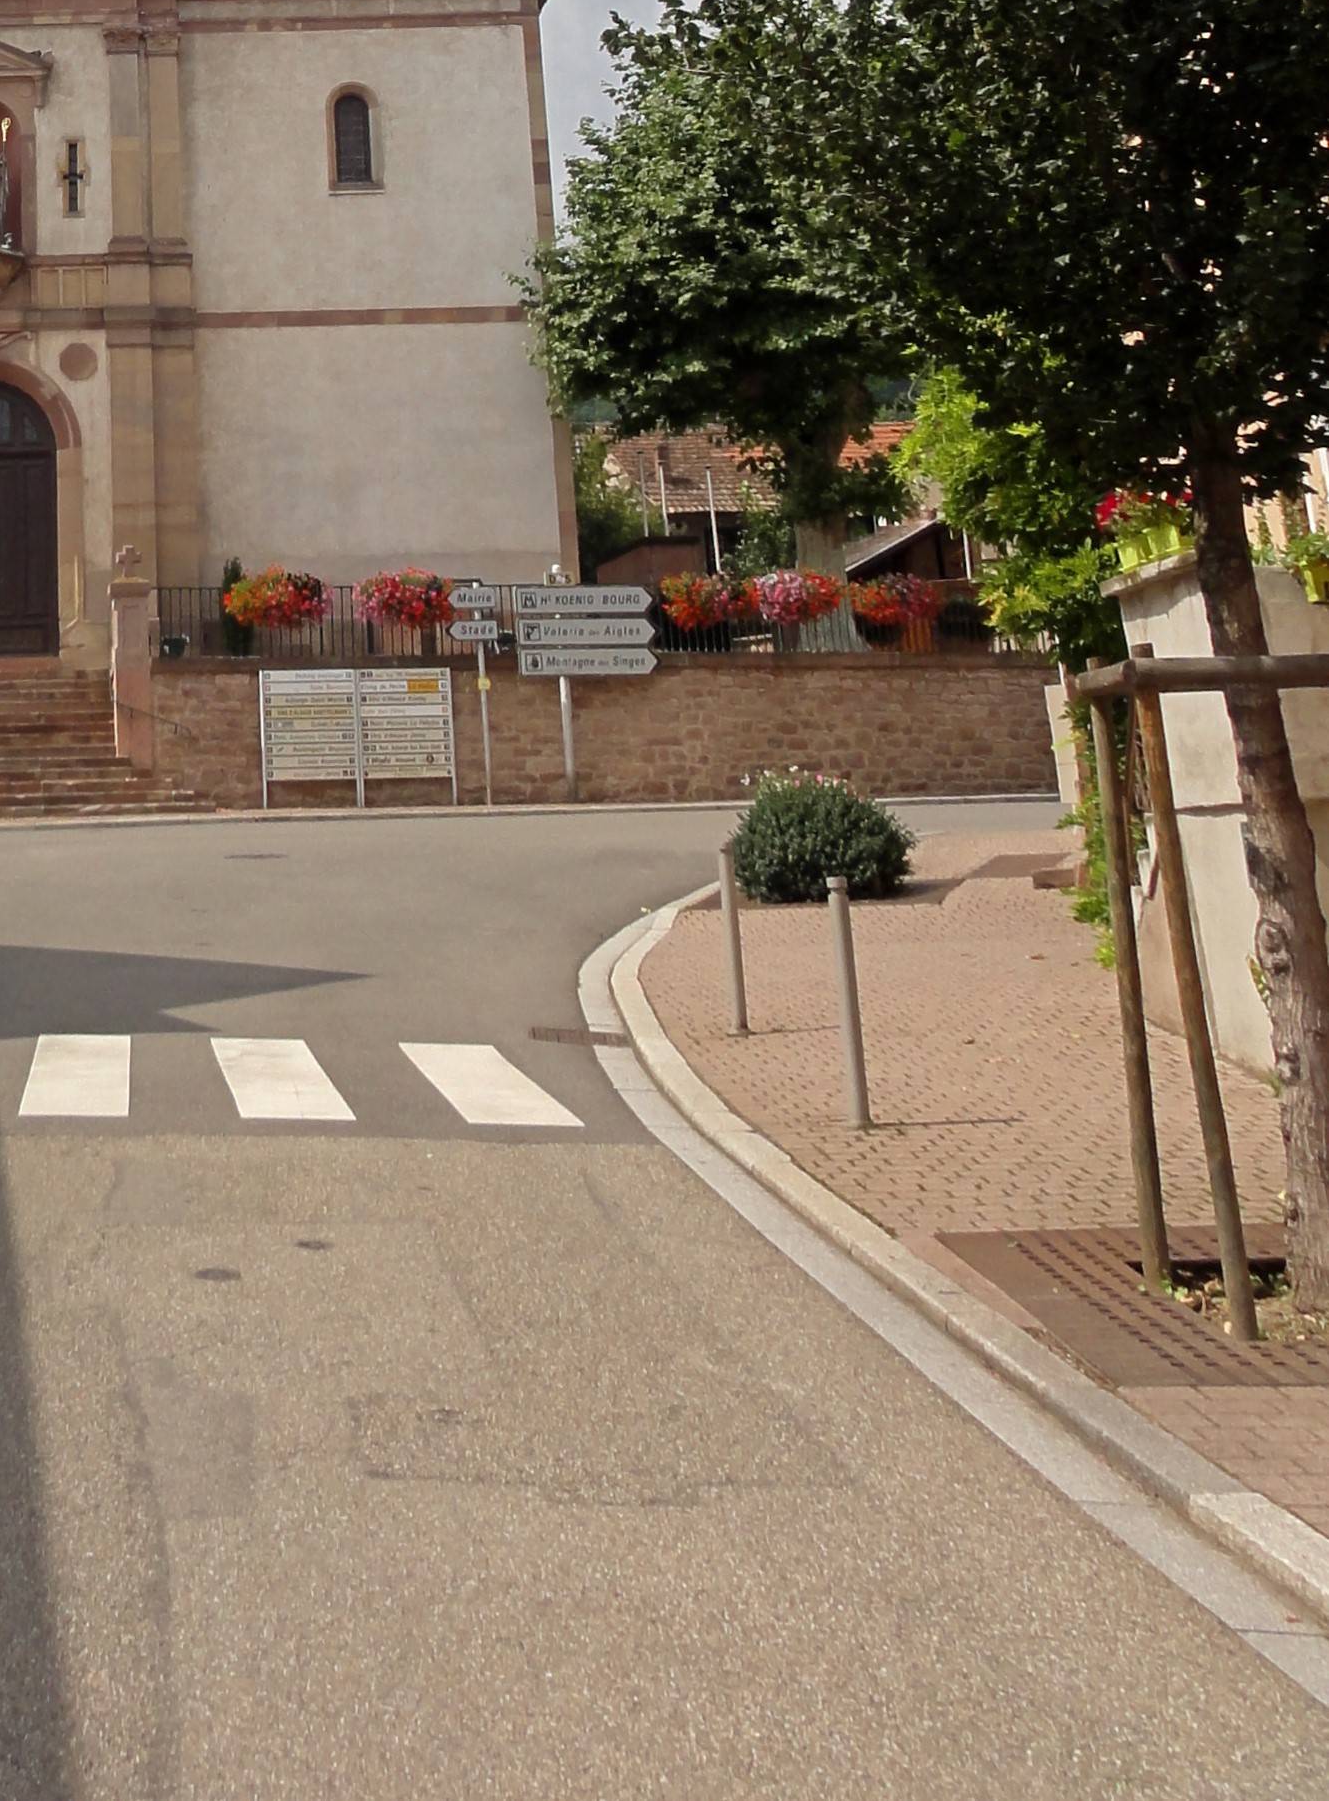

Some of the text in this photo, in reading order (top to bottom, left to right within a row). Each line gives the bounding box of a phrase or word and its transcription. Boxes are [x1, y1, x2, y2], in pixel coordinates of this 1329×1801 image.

[456, 593, 492, 603] Mairie
[555, 594, 594, 605] KOENIG
[602, 594, 640, 605] BOURG
[461, 624, 494, 635] Stade
[604, 626, 641, 637] Aigles
[546, 656, 596, 668] Montagne
[613, 656, 646, 668] Singes
